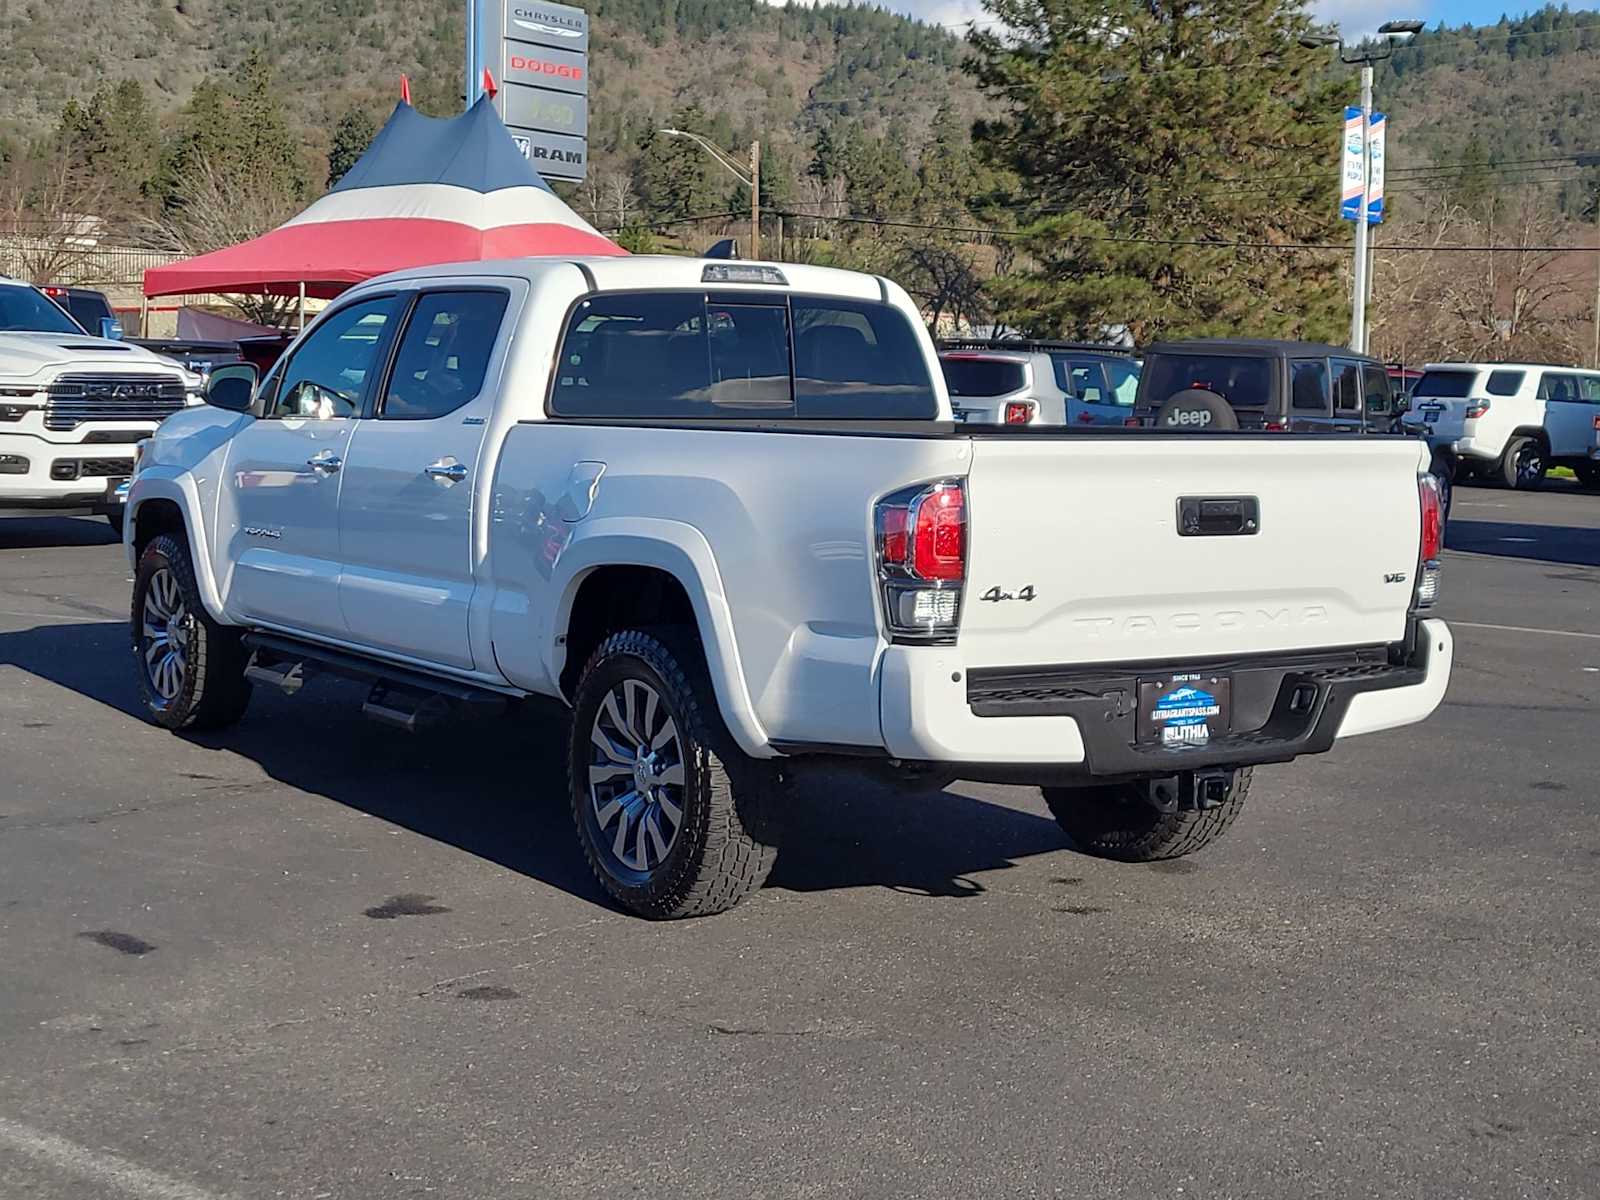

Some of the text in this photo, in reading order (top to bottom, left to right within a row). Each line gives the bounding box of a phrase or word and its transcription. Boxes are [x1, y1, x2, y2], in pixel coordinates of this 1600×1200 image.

[514, 8, 583, 29] CHRYSLER
[511, 56, 584, 81] DODGE
[533, 146, 583, 165] RAM
[1167, 407, 1212, 428] Jeep
[1383, 572, 1406, 583] V6
[979, 585, 1037, 602] 4x4
[1073, 605, 1329, 637] TACOMA
